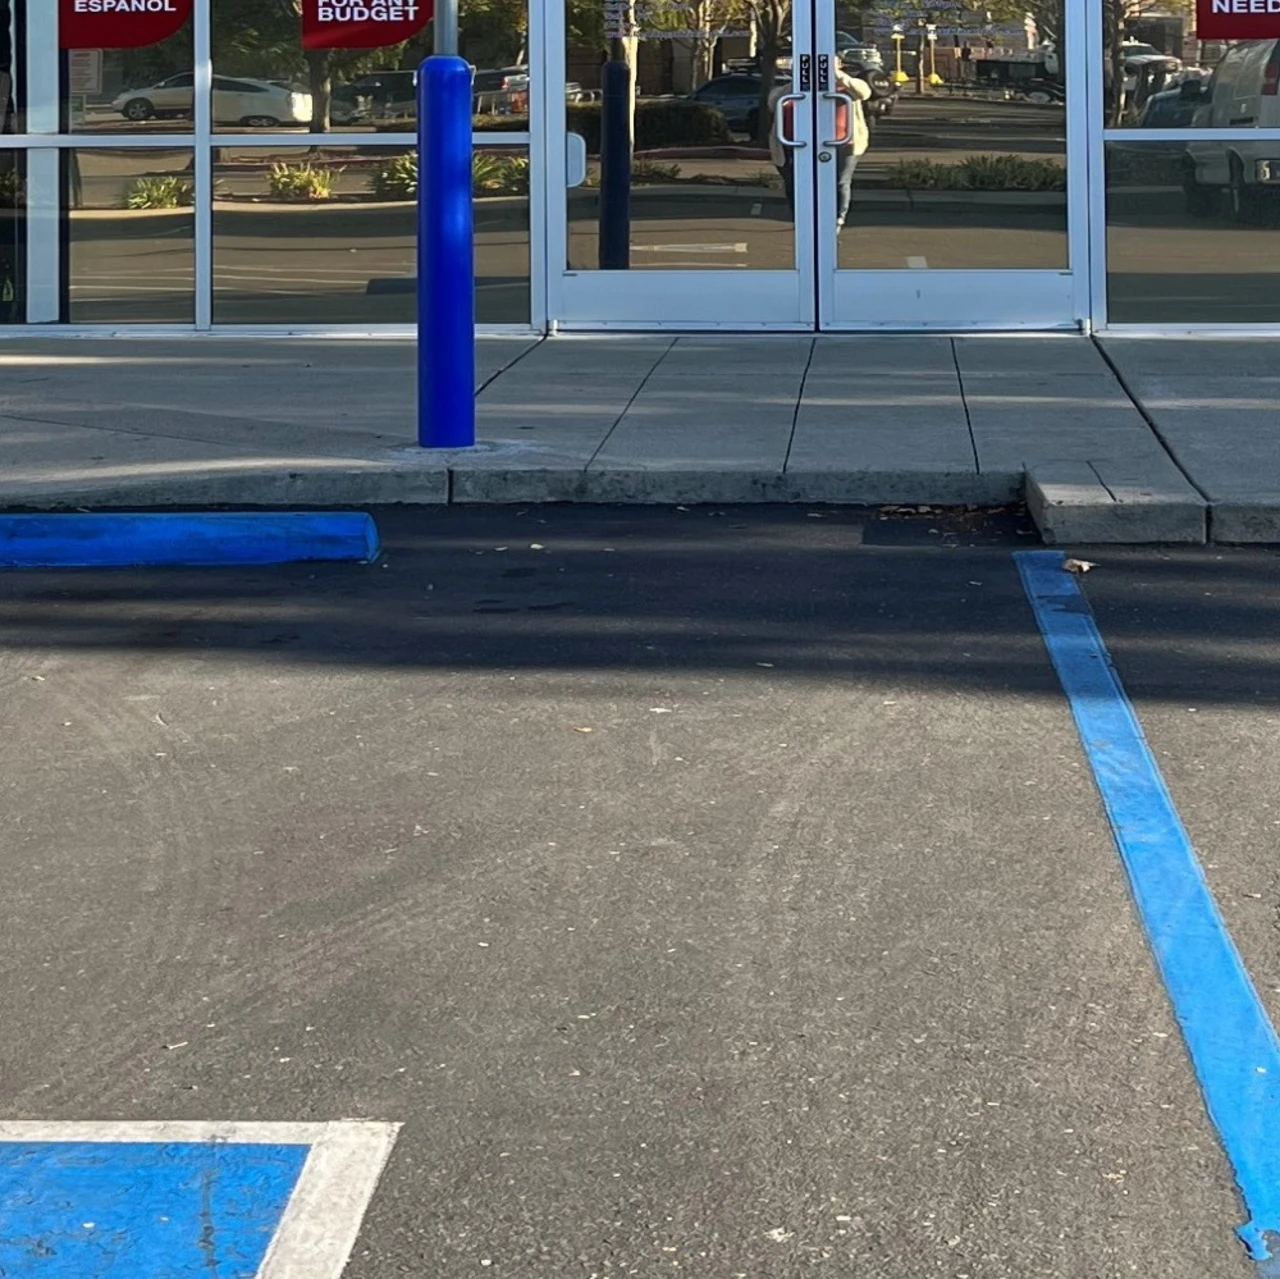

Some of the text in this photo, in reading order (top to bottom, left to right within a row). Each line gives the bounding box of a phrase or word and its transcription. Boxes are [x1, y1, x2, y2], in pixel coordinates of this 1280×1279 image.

[318, 6, 419, 21] BUDGET
[801, 55, 810, 83] PULL
[820, 55, 828, 83] PULL
